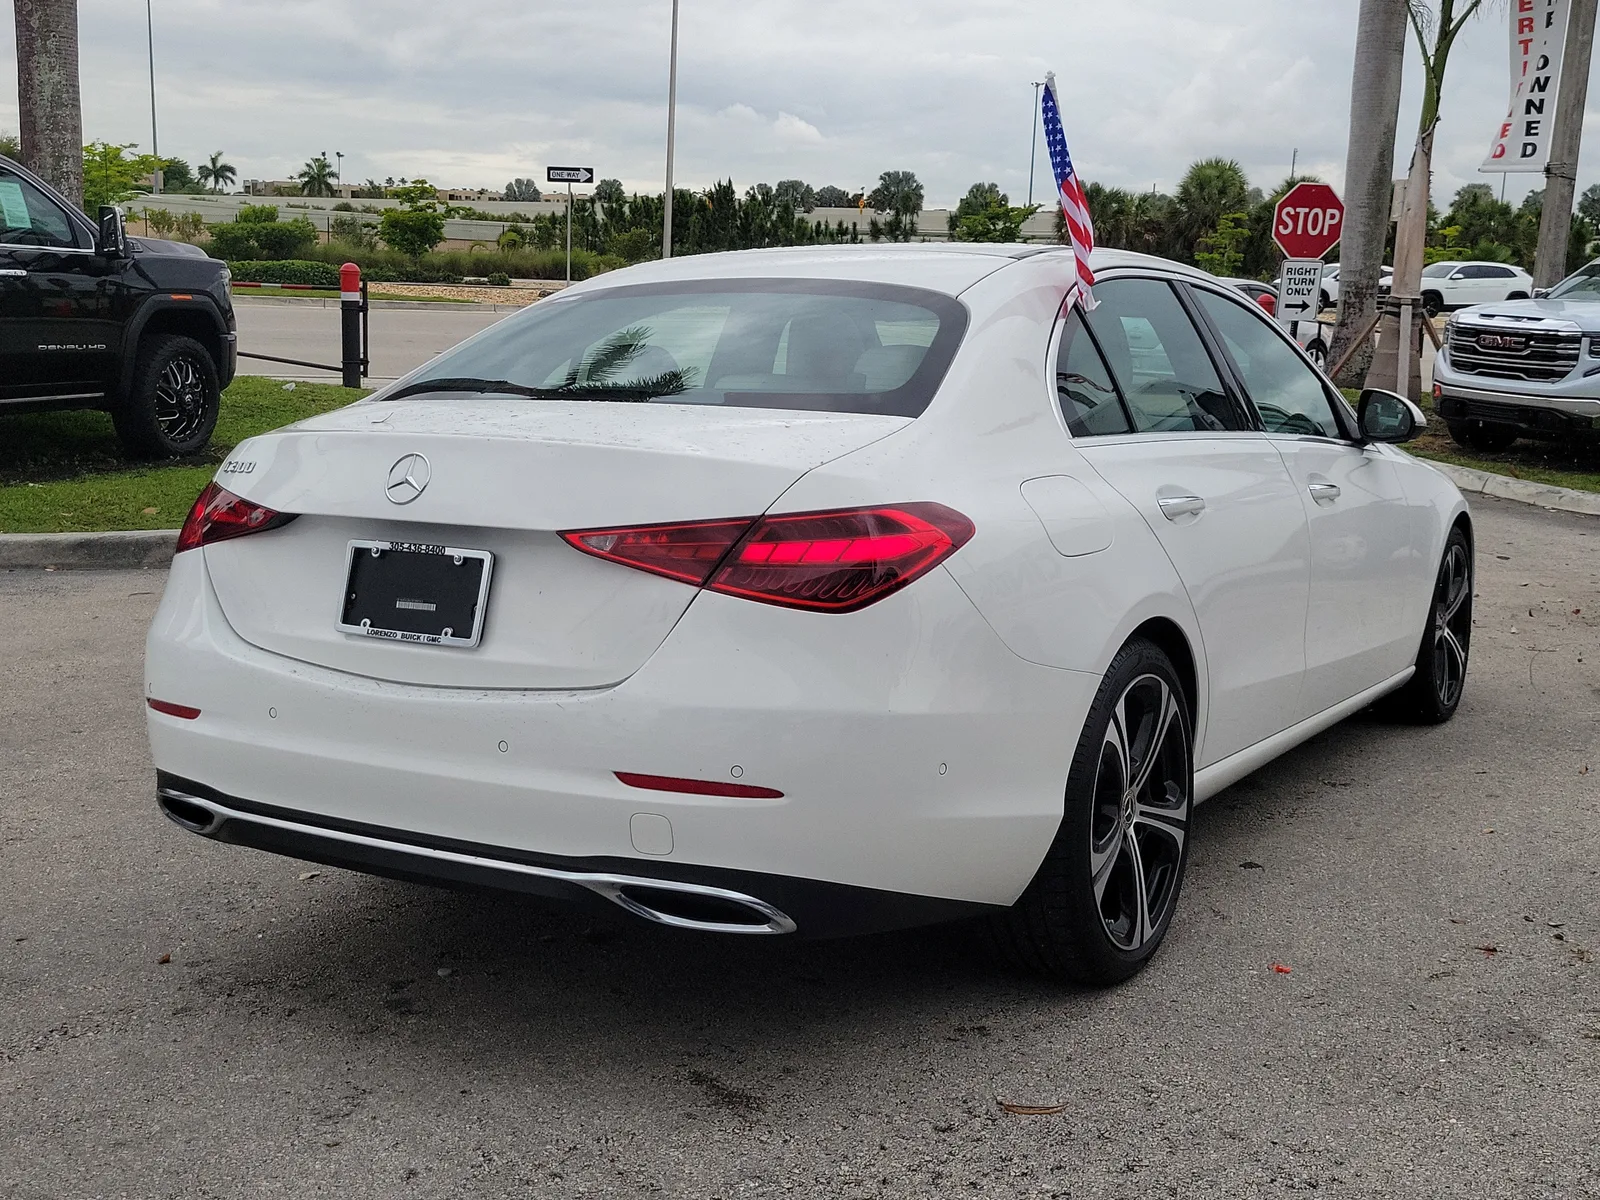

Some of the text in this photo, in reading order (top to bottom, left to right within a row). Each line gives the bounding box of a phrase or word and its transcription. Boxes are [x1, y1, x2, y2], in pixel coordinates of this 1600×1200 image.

[1492, 0, 1534, 159] ERTIED
[566, 171, 580, 179] WAY
[1278, 206, 1340, 236] STOP
[1286, 267, 1319, 276] RIGHT
[1287, 277, 1316, 286] TURN
[1286, 287, 1313, 296] ONLY
[1478, 334, 1526, 349] GMC
[388, 541, 447, 556] 305-436-8400
[366, 628, 398, 639] LORENZO
[400, 632, 422, 641] BUICK
[426, 635, 442, 643] GMC
